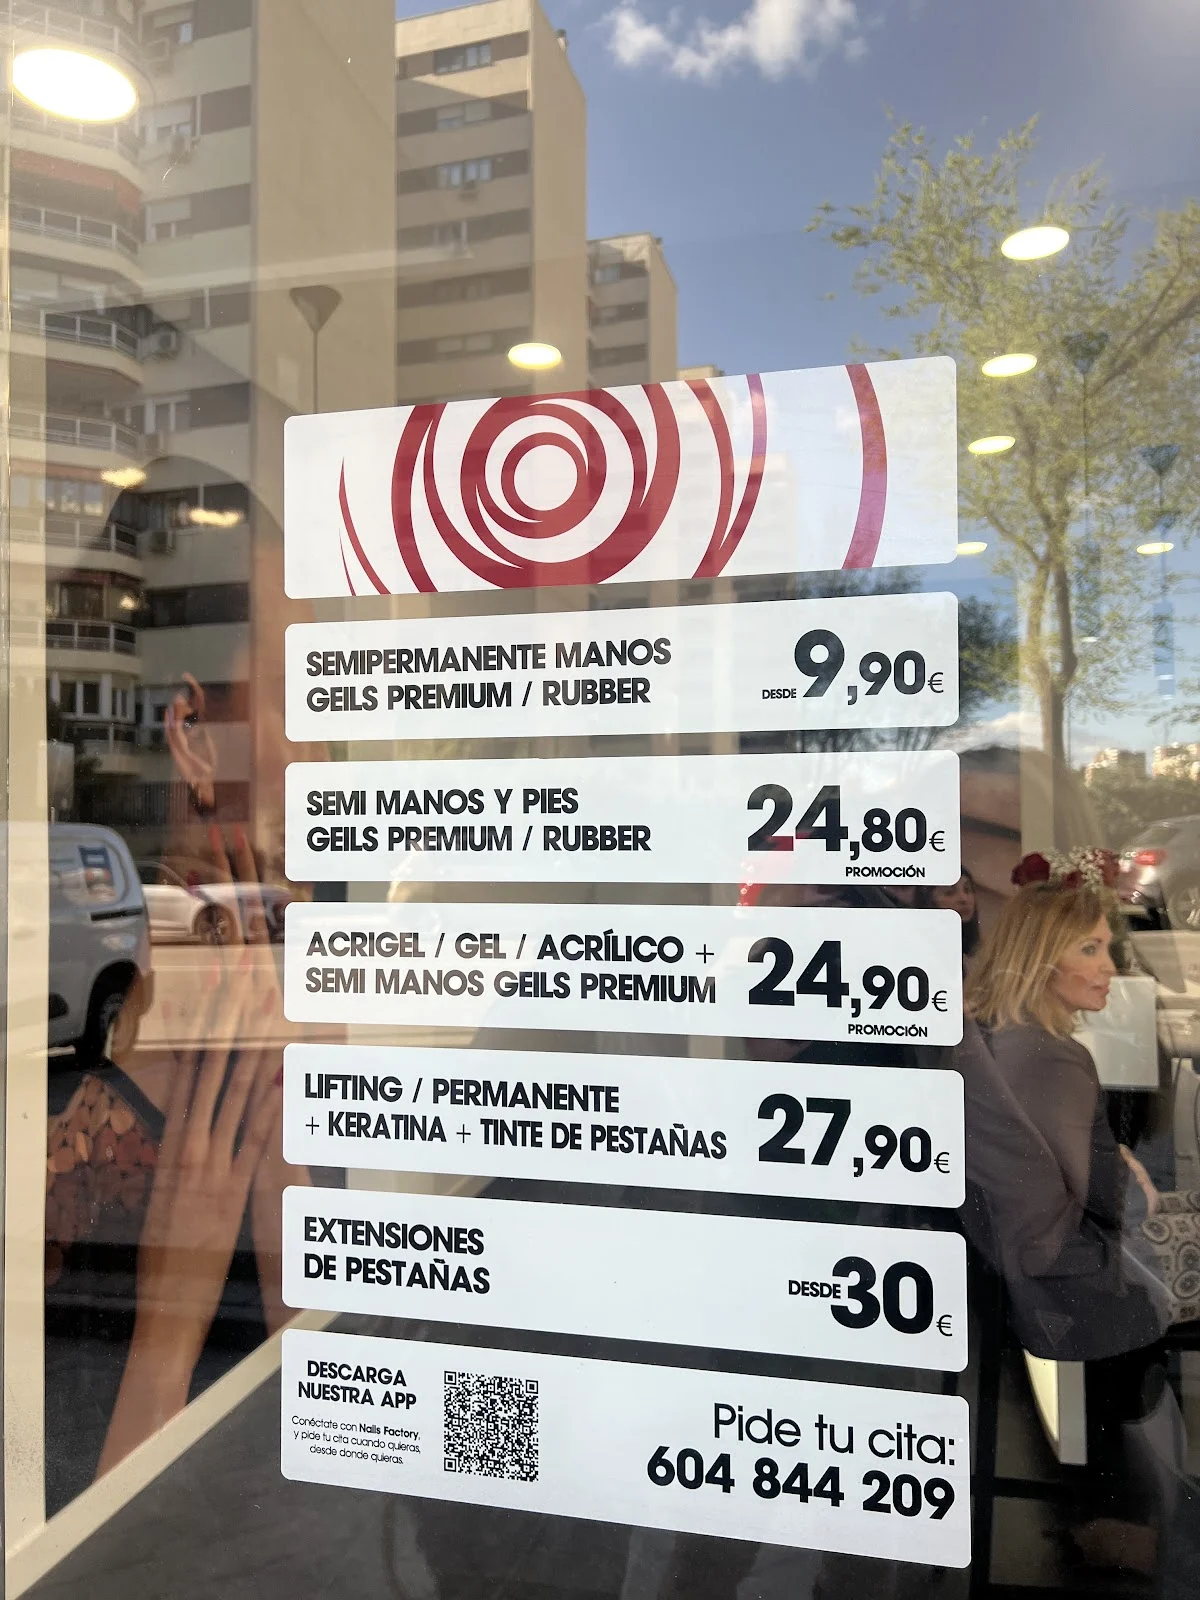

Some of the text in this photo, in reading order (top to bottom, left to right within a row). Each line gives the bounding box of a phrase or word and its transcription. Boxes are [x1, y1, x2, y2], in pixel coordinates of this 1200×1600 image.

[307, 638, 671, 676] SEMIPERMANENTE MANOS
[762, 629, 944, 705] DESDE 9,90€
[307, 677, 651, 712] GEILS PREMIUM / RUBBER
[307, 788, 578, 816] SEMI MANOS Y PIES
[307, 825, 651, 852] GEILS PREMIUM / RUBBER
[747, 784, 945, 861] 24,80€
[846, 864, 925, 877] PROMOCIÓN
[306, 929, 714, 964] ACRIGEL / GEL / ACRÍLICO +
[305, 967, 716, 1003] SEMI MANOS GEILS PREMIUM
[748, 937, 948, 1018] 24,90€
[848, 1024, 927, 1037] PROMOCIÓN
[305, 1073, 619, 1113] LIFTING / PERMANENTE
[305, 1111, 727, 1159] + KERATINA + TINTE DE PESTAÑAS
[758, 1093, 950, 1177] 27,90€
[304, 1216, 484, 1255] EXTENSIONES
[304, 1253, 490, 1294] DE PESTAÑAS
[788, 1256, 953, 1337] DESDE 30€
[307, 1360, 407, 1387] DESCARGA
[298, 1381, 417, 1410] NUESTRA APP
[291, 1415, 420, 1441] Conéctate con Nails Factory,
[293, 1430, 421, 1454] y pide tu cita cuando quieras,
[714, 1403, 955, 1466] Pide tu cita:
[309, 1445, 403, 1464] desde donde quieras.
[647, 1446, 955, 1520] 604 844 209
